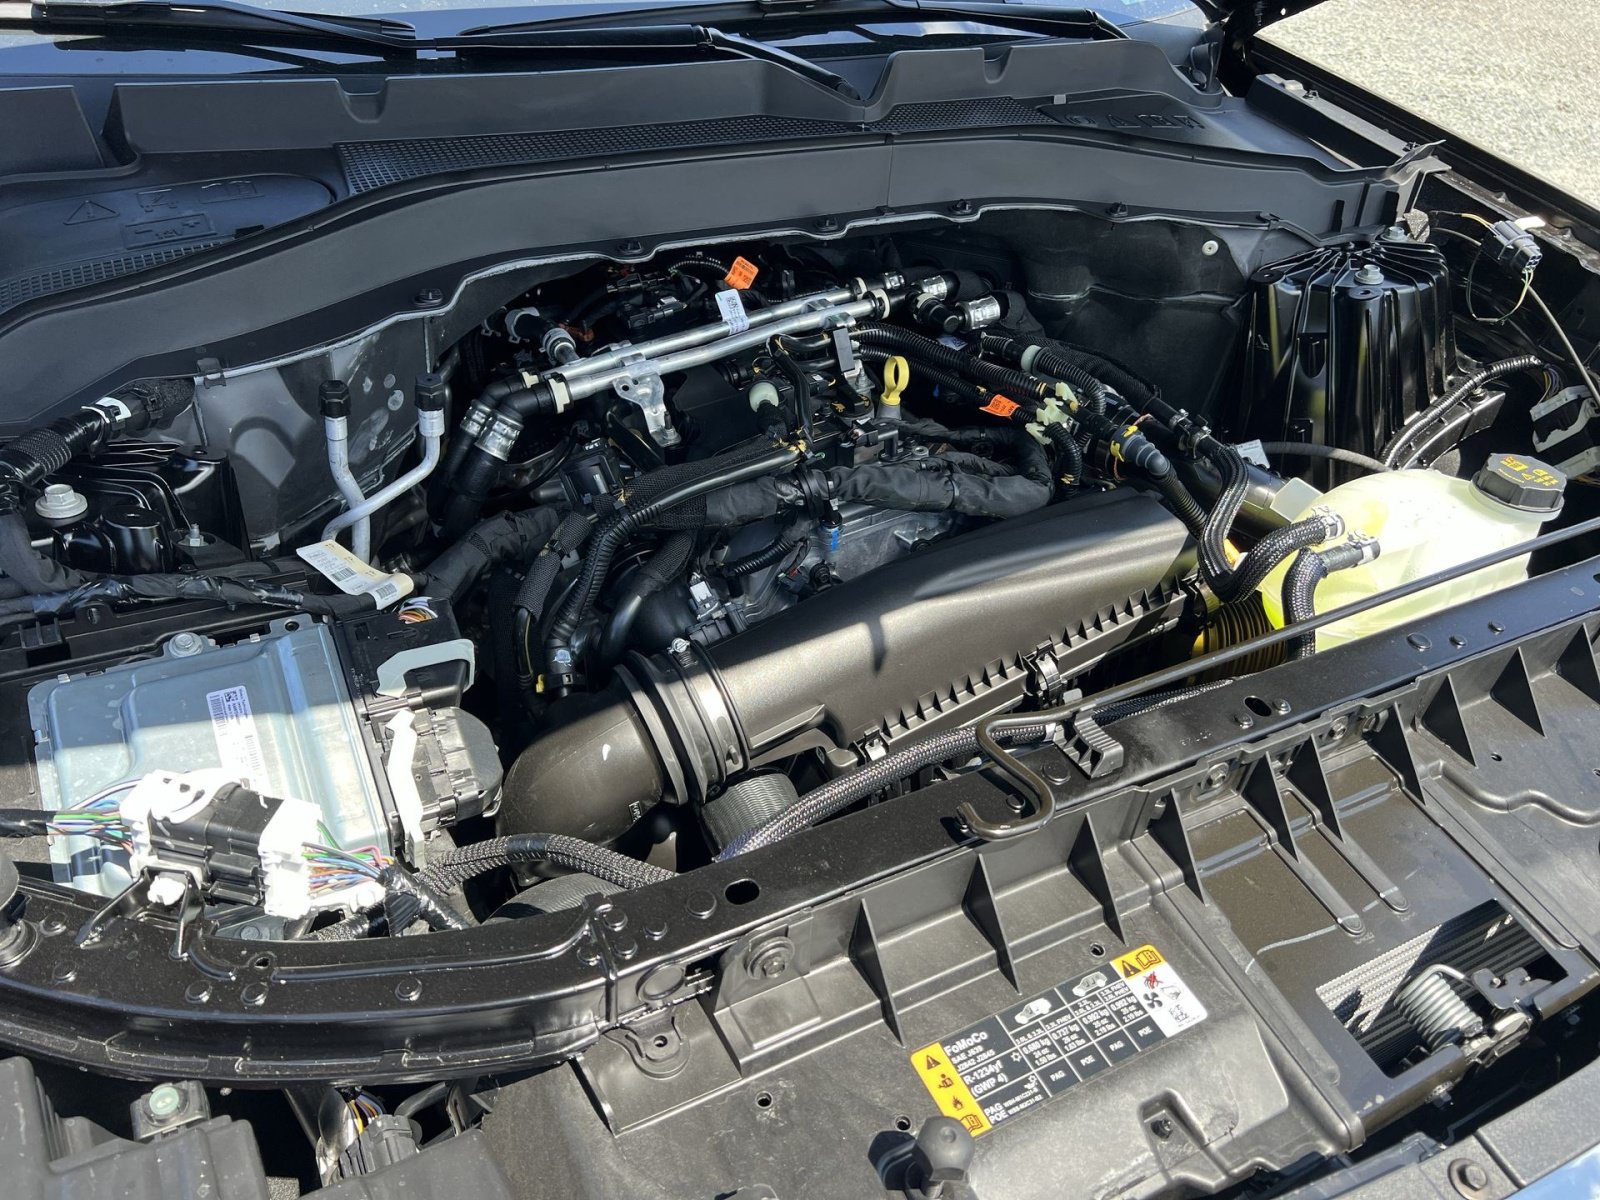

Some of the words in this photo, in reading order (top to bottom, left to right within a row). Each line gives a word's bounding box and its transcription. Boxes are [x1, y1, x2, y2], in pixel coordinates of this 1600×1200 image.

[943, 1031, 988, 1056] FoMoCo
[950, 1052, 968, 1065] SAE
[1080, 1055, 1095, 1066] POE
[962, 1059, 1004, 1085] R-1234yf
[970, 1077, 997, 1098] (GWP
[983, 1102, 1004, 1117] PAG
[988, 1109, 1009, 1125] POE
